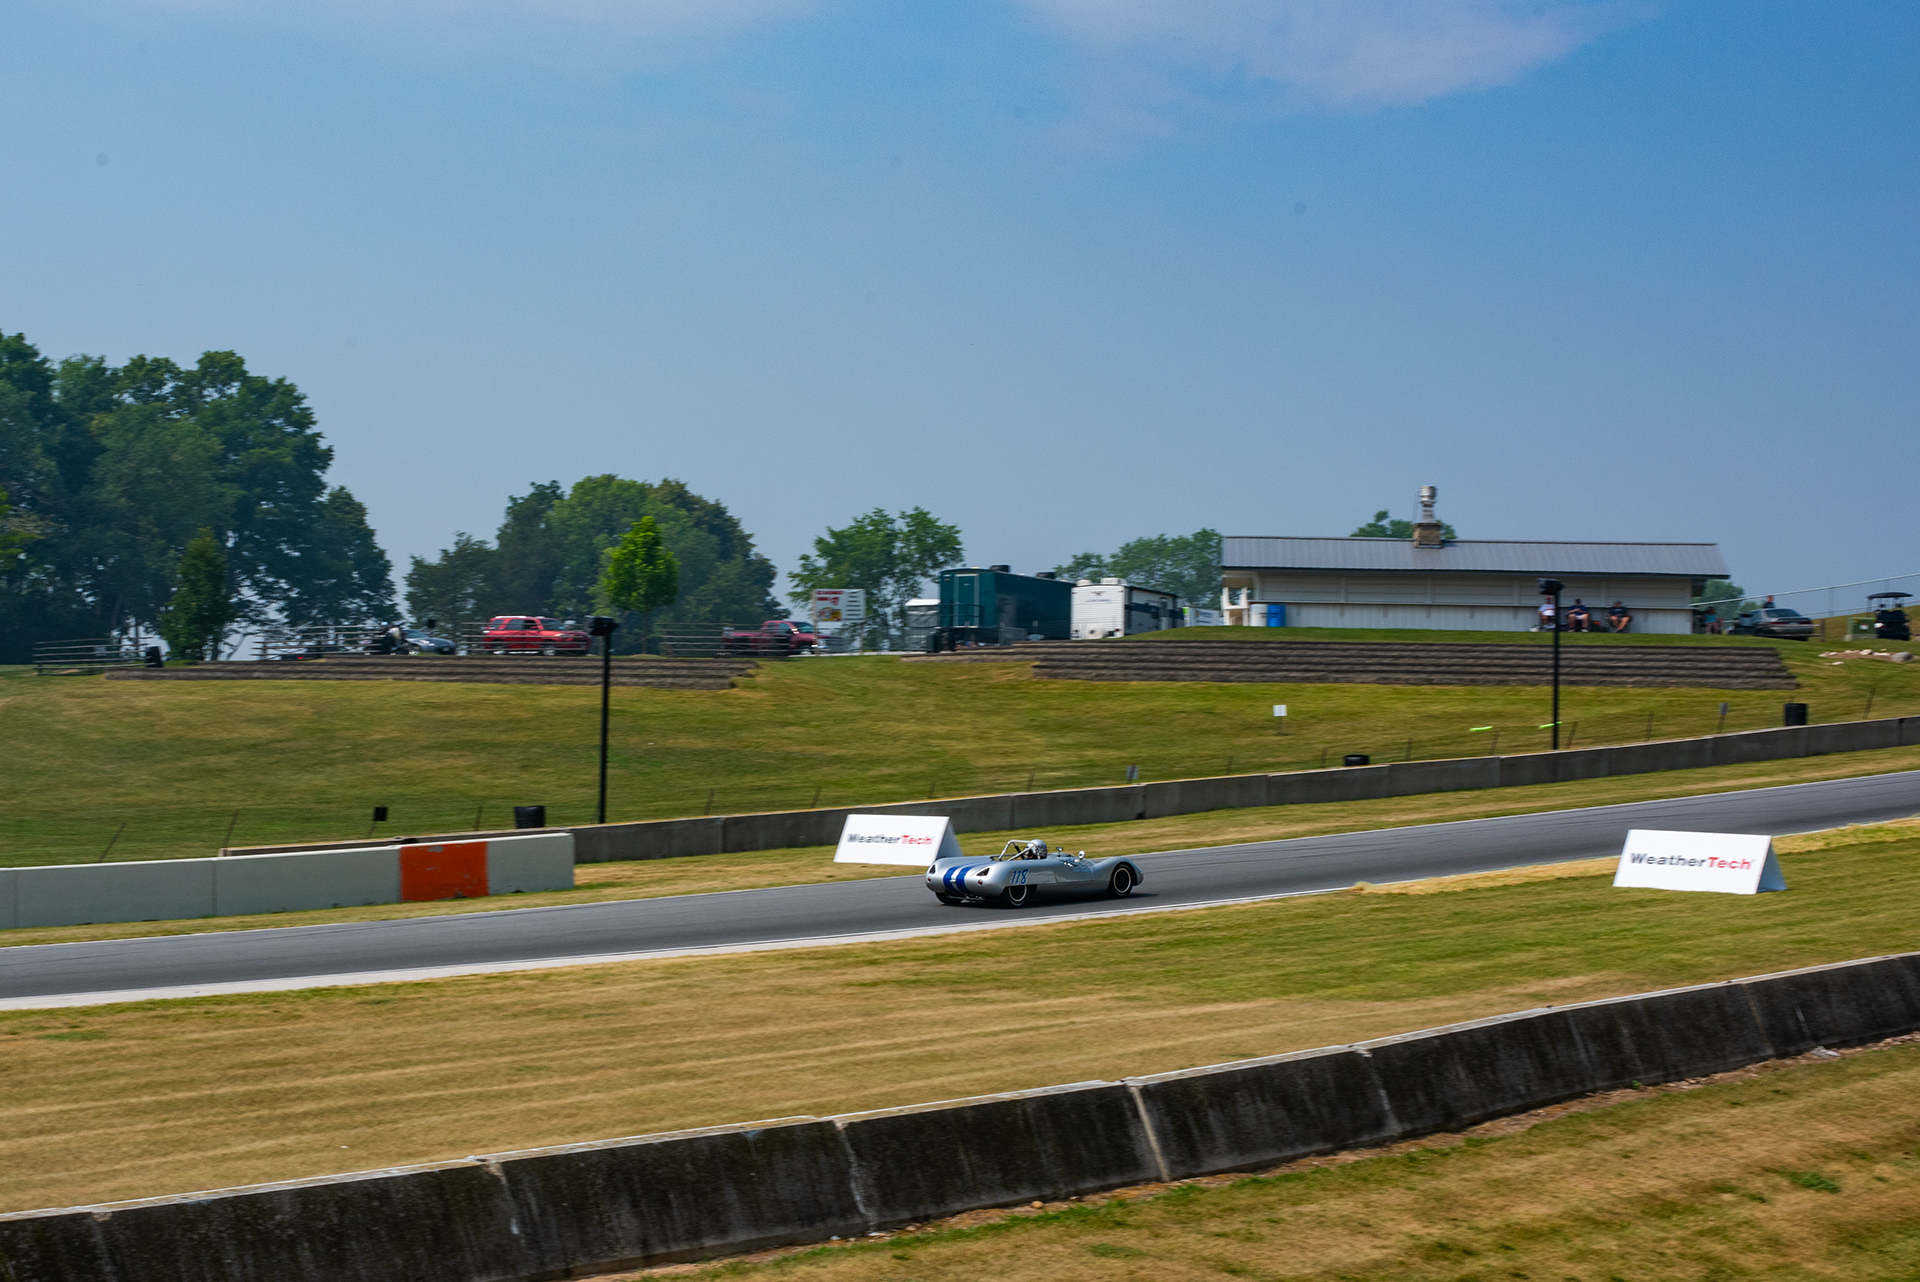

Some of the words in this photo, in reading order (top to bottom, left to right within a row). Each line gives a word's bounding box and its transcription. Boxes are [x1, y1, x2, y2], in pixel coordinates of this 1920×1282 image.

[848, 833, 932, 845] WeatherTech
[1631, 852, 1751, 870] WeatherTech
[1011, 868, 1029, 885] 118
